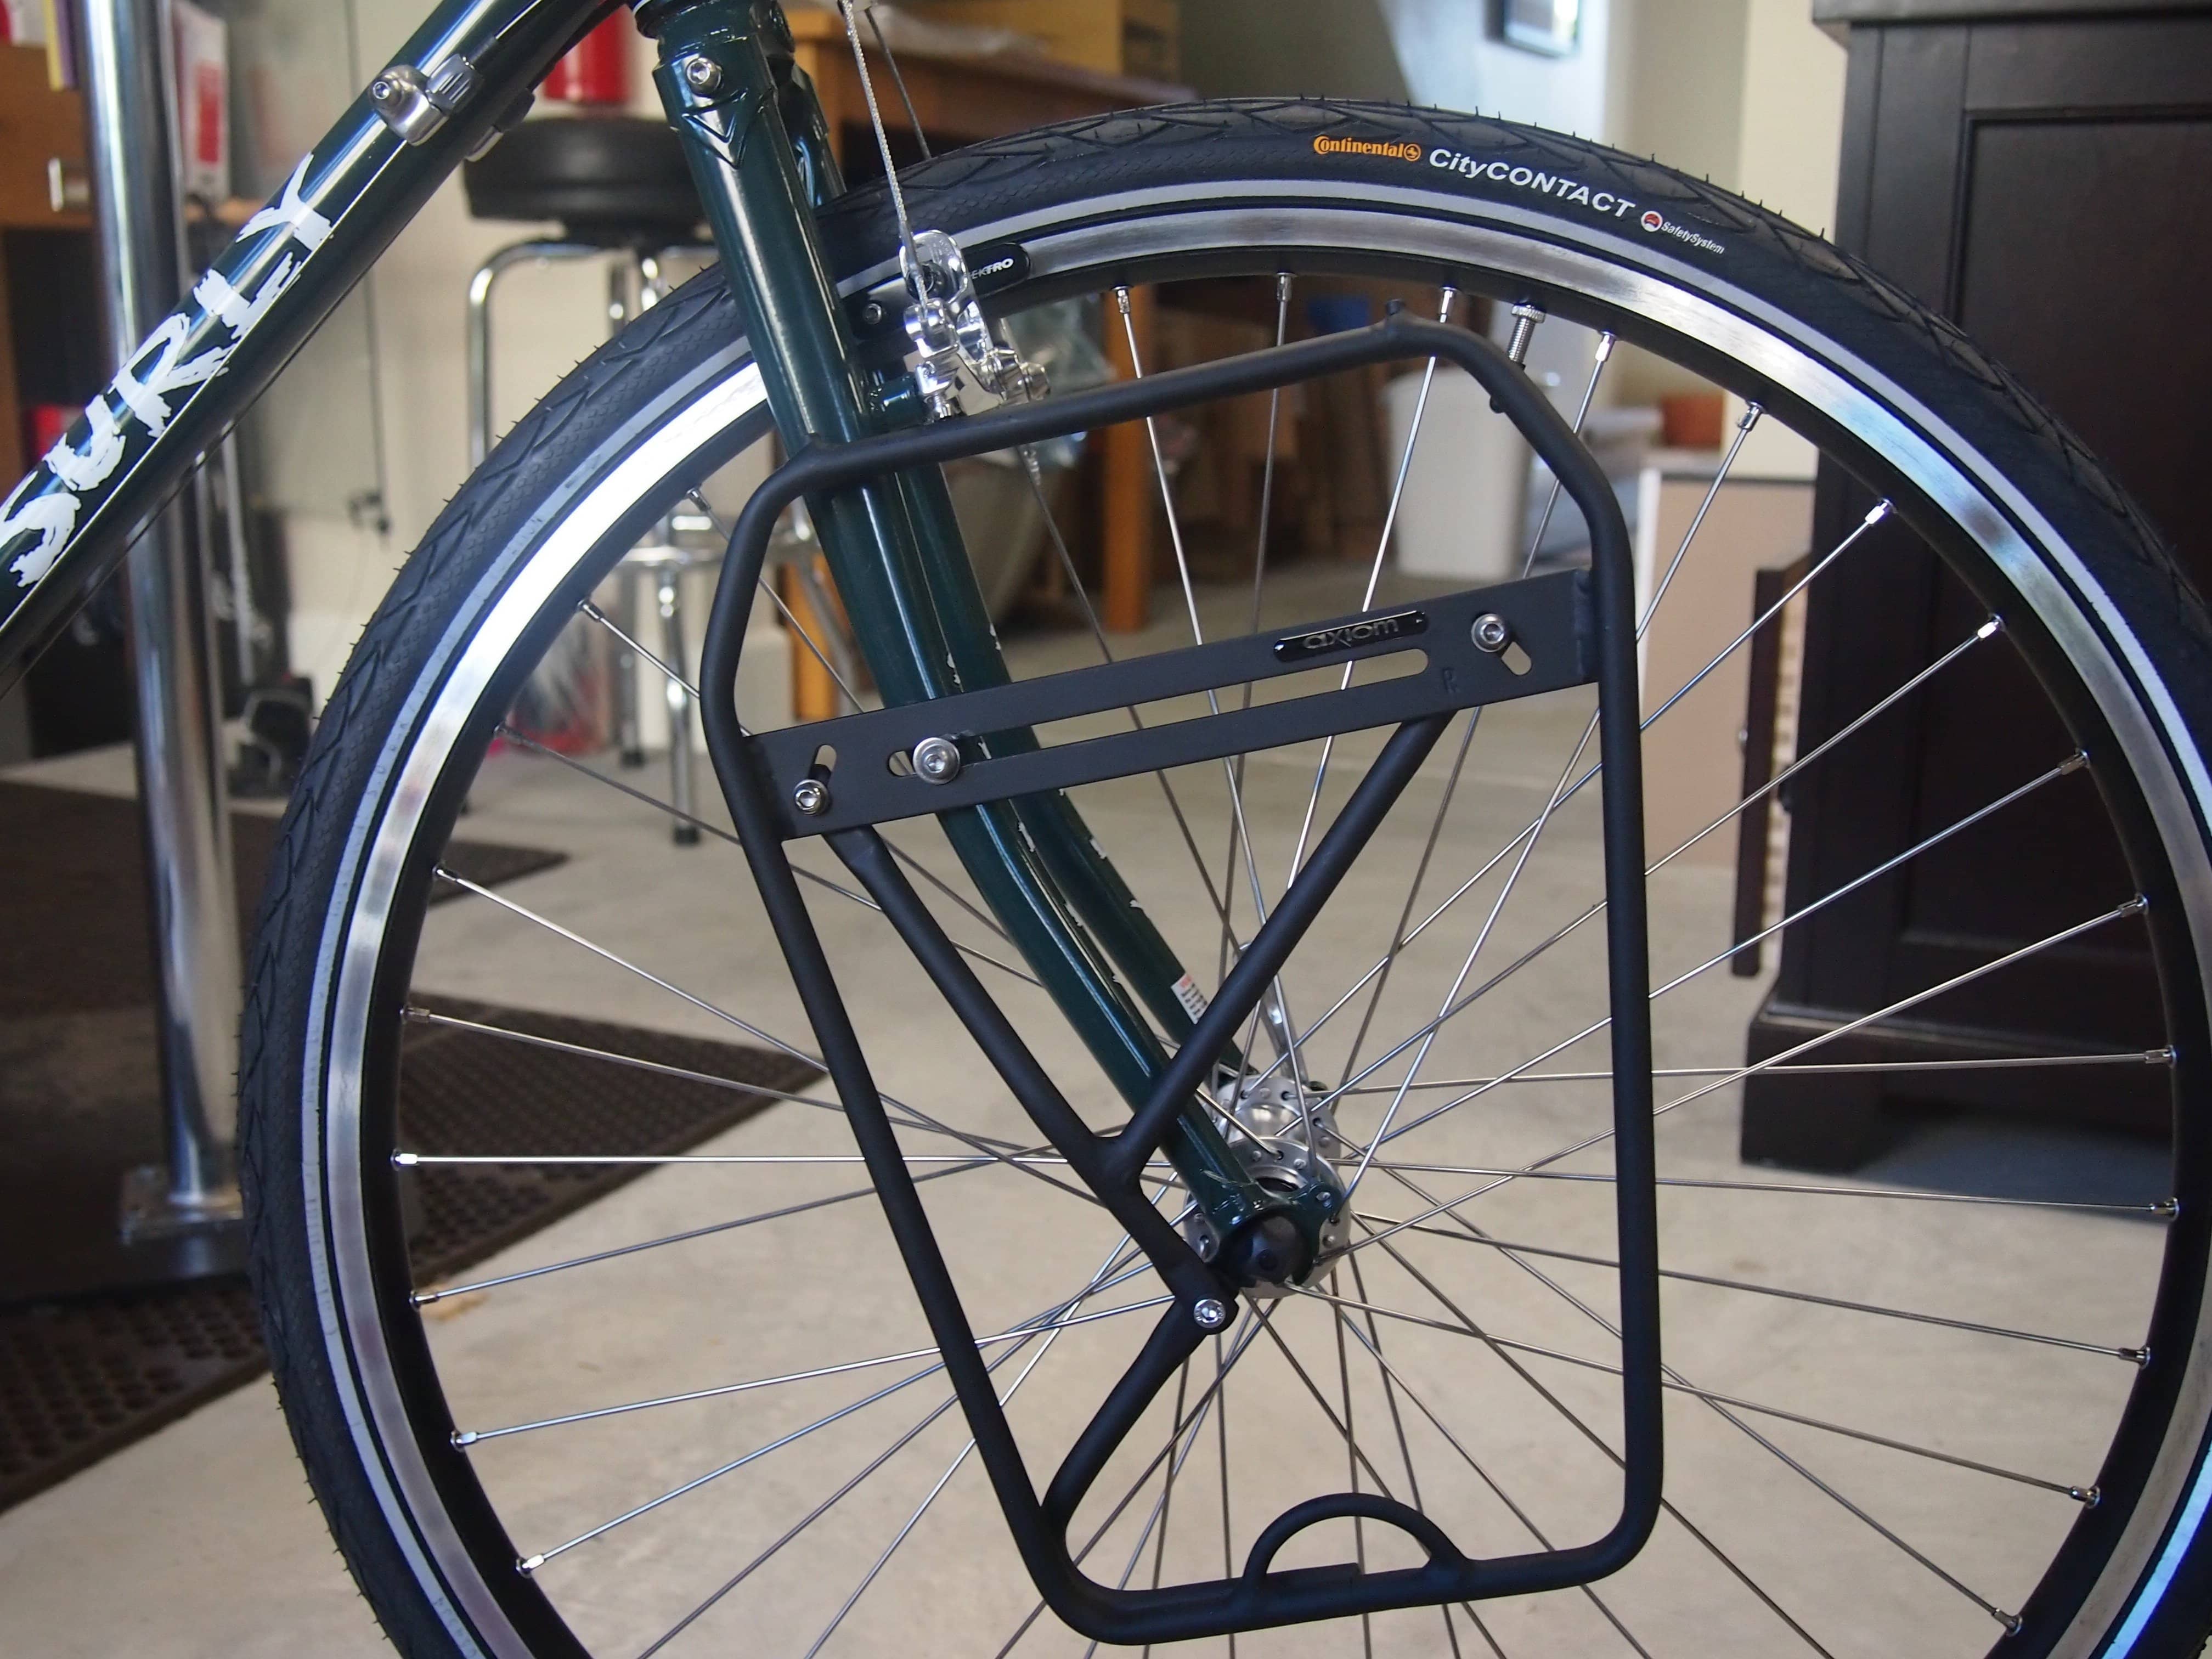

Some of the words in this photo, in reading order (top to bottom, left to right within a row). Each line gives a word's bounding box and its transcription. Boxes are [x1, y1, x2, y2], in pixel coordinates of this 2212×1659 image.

[1313, 136, 1404, 159] Continental
[1429, 149, 1636, 217] CityCONTACT
[1661, 221, 1725, 255] SafetySystem
[968, 258, 1014, 280] EKTRO
[0, 152, 334, 588] SURLY
[1303, 618, 1400, 650] axiom
